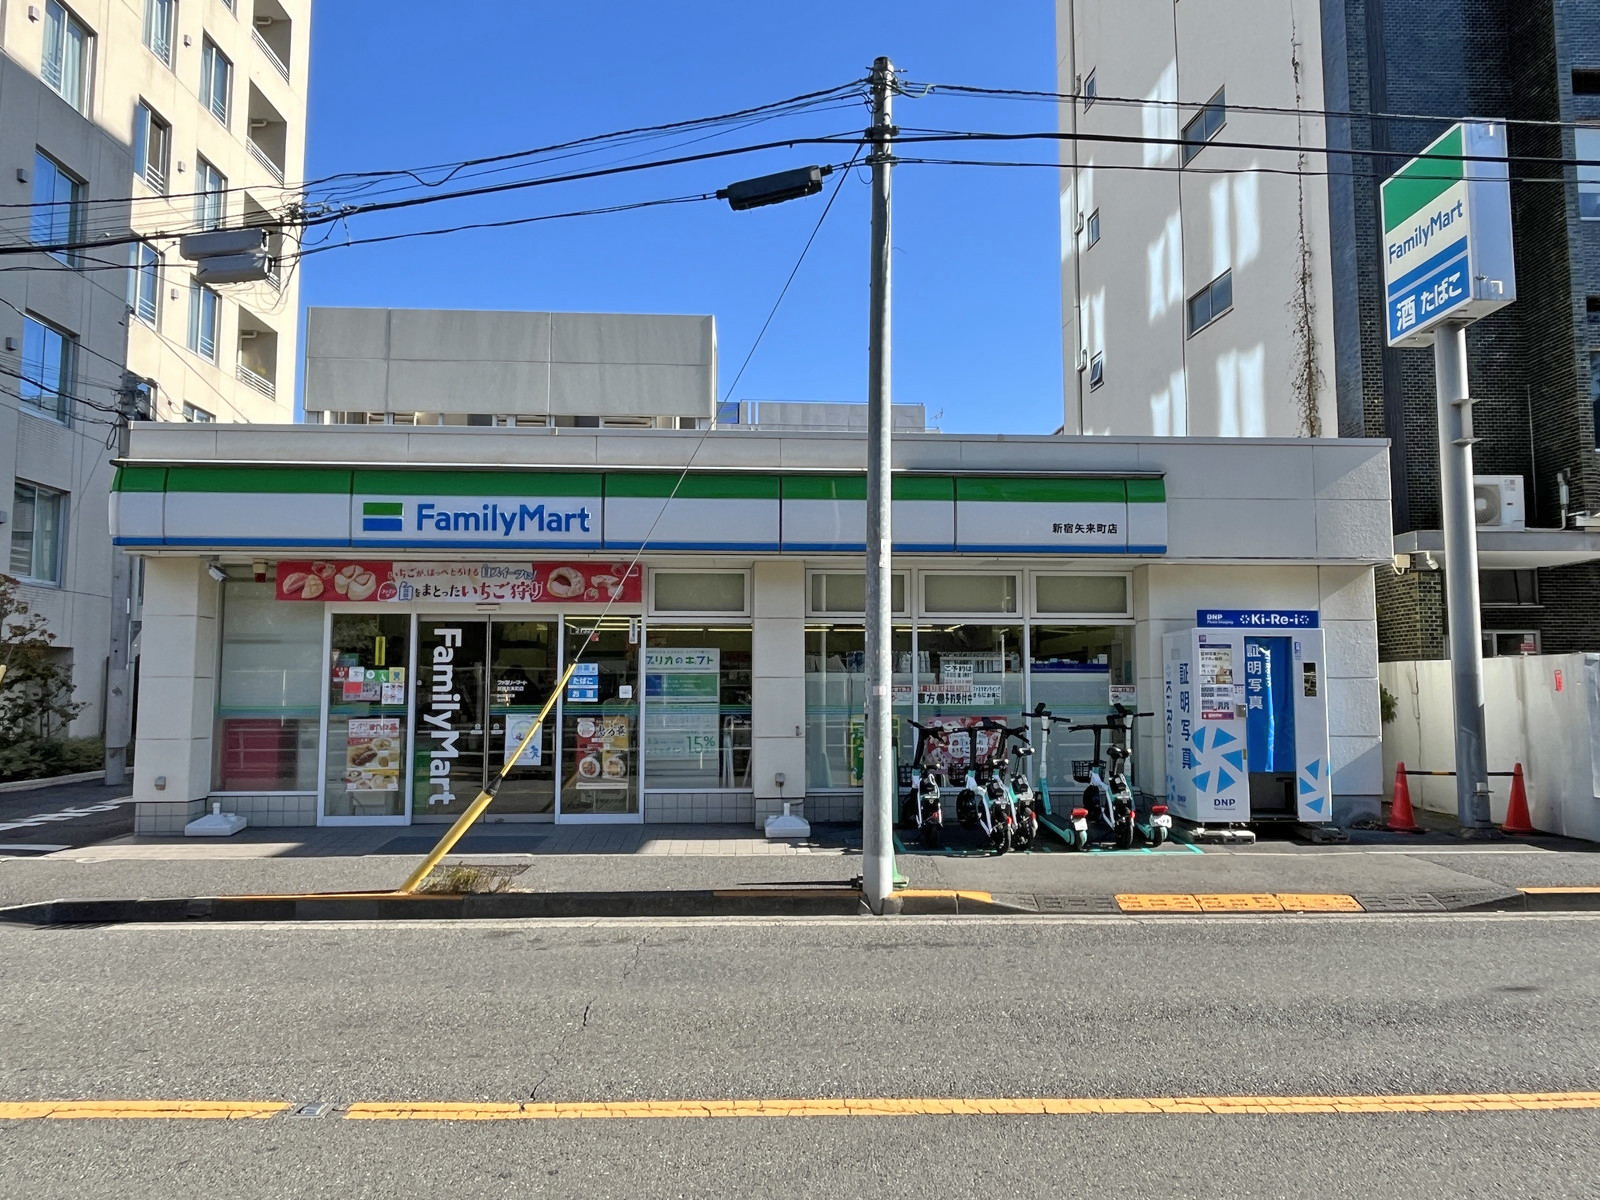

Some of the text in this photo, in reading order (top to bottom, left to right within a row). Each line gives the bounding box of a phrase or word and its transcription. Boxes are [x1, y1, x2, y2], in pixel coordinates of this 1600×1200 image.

[1389, 199, 1463, 264] FamilyMart
[1396, 271, 1462, 331] 酒 たばこ
[416, 503, 591, 536] FamilyMart
[1052, 523, 1118, 534] 新宿矢来町店
[1251, 613, 1298, 625] Ki-Re-i
[944, 665, 972, 673] ご予約は
[1246, 643, 1264, 710] 証明写真
[572, 677, 594, 685] たばこ
[423, 628, 463, 805] FamilyMart
[1213, 798, 1236, 806] DNP
